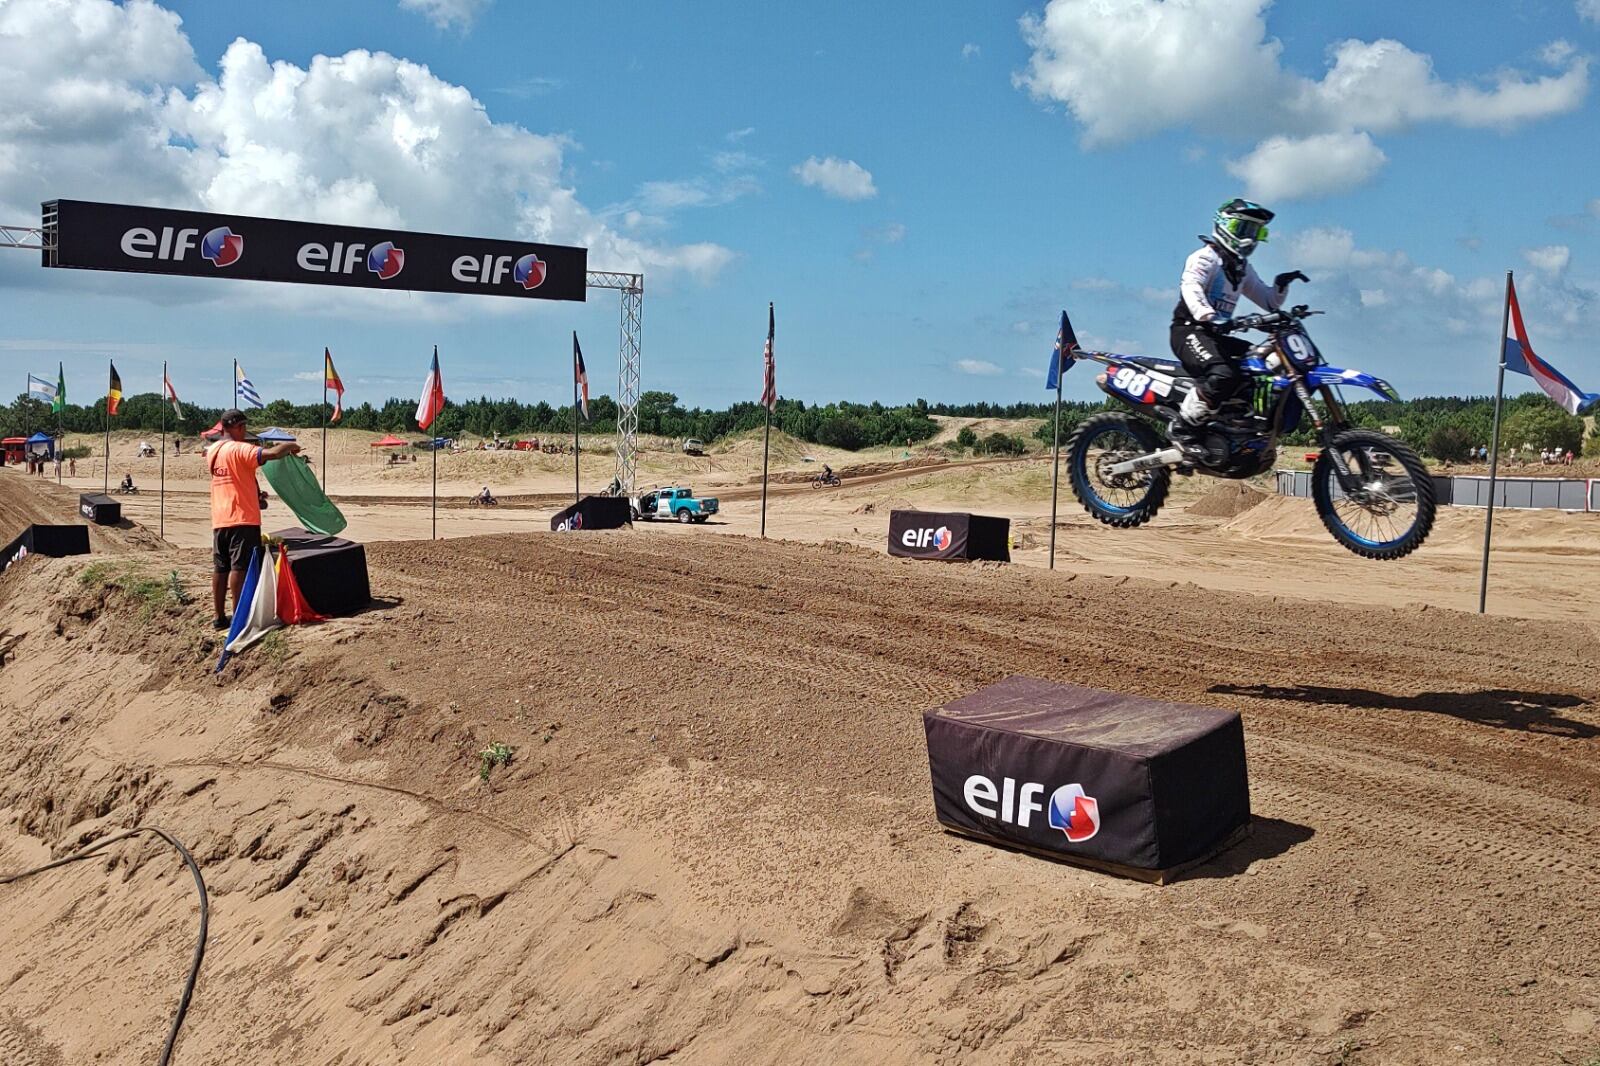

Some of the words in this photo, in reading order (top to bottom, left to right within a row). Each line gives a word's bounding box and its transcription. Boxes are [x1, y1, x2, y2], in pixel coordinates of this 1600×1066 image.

[120, 227, 199, 261] elf
[297, 242, 366, 274] elf
[451, 255, 513, 284] elf
[1113, 367, 1151, 397] 98
[902, 527, 934, 548] elf
[963, 774, 1045, 828] elf
